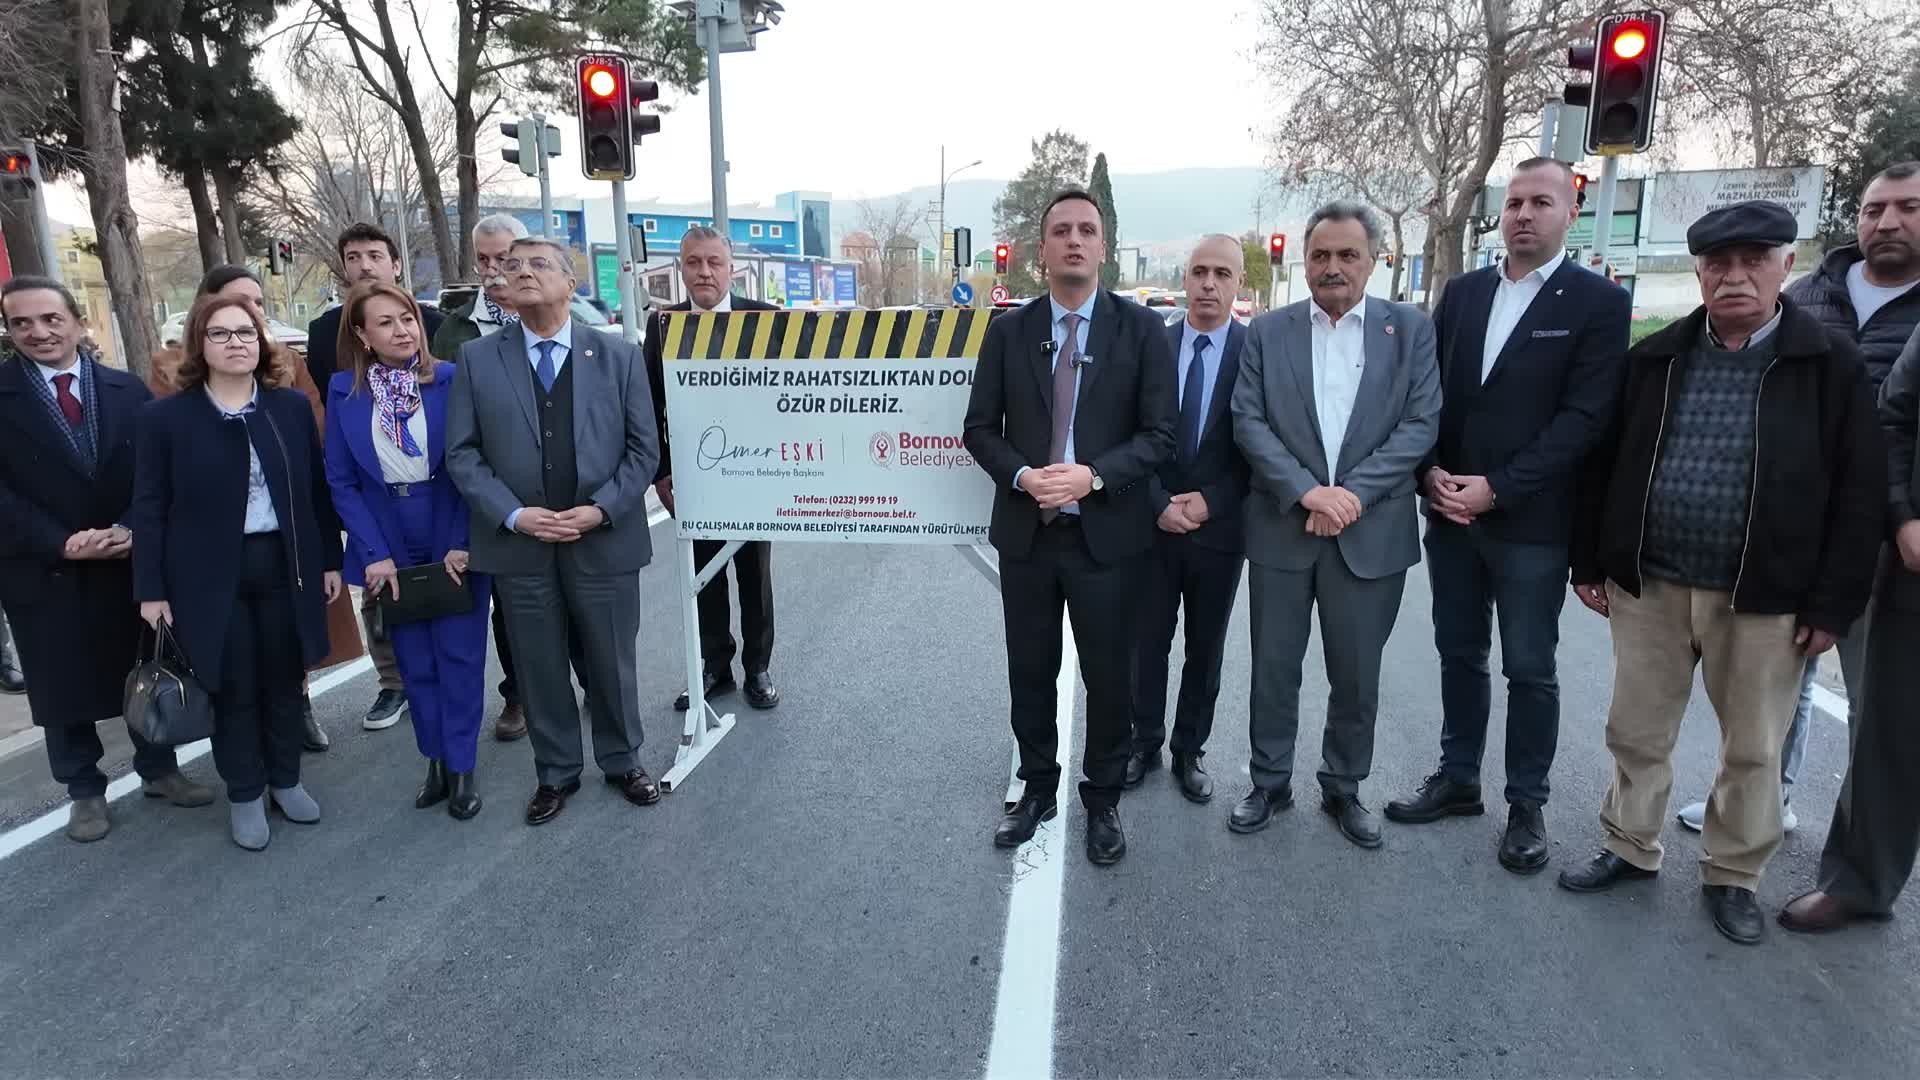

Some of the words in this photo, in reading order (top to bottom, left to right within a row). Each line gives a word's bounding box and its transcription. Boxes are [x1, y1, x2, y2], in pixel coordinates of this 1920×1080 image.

[676, 366, 779, 387] VERDİĞİMİZ
[783, 369, 935, 387] RAHATSIZLIKTAN
[938, 369, 974, 387] DOL
[776, 393, 826, 414] ÖZÜR
[829, 392, 904, 414] DİLERİZ.
[898, 431, 964, 450] Bornov
[780, 438, 825, 467] EŞKİ
[793, 494, 829, 505] Telefon:
[829, 494, 857, 506] (0232)
[858, 495, 875, 505] 999
[877, 495, 887, 505] 19
[888, 496, 899, 505] 19
[681, 520, 695, 531] BU
[696, 520, 755, 533] ÇALIŞMALAR
[756, 522, 803, 533] BORNOVA
[804, 521, 858, 534] BELEDİYESİ
[859, 523, 920, 535] TARAFINDAN
